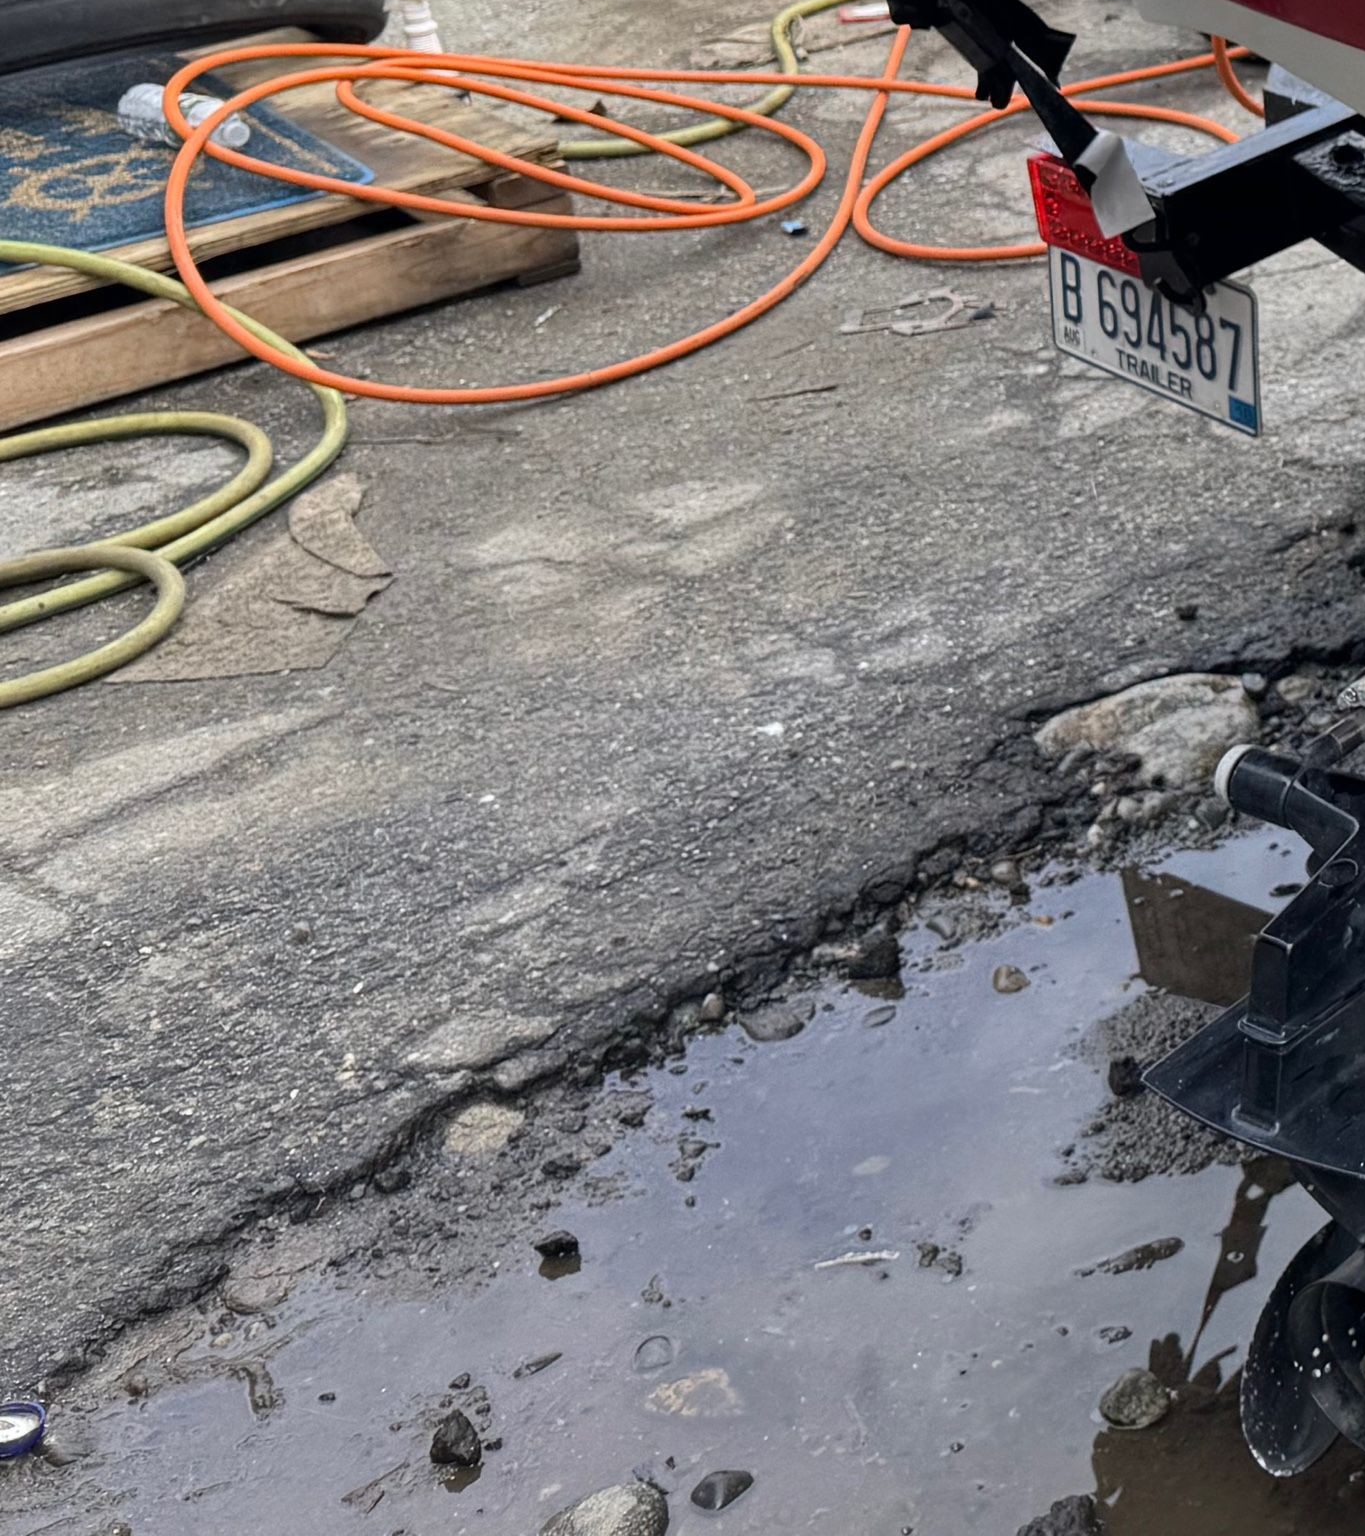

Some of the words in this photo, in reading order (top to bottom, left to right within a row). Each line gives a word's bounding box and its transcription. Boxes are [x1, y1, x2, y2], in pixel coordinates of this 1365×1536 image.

[1060, 252, 1083, 325] B
[1097, 269, 1242, 392] 694587
[1116, 347, 1194, 400] TRAILER
